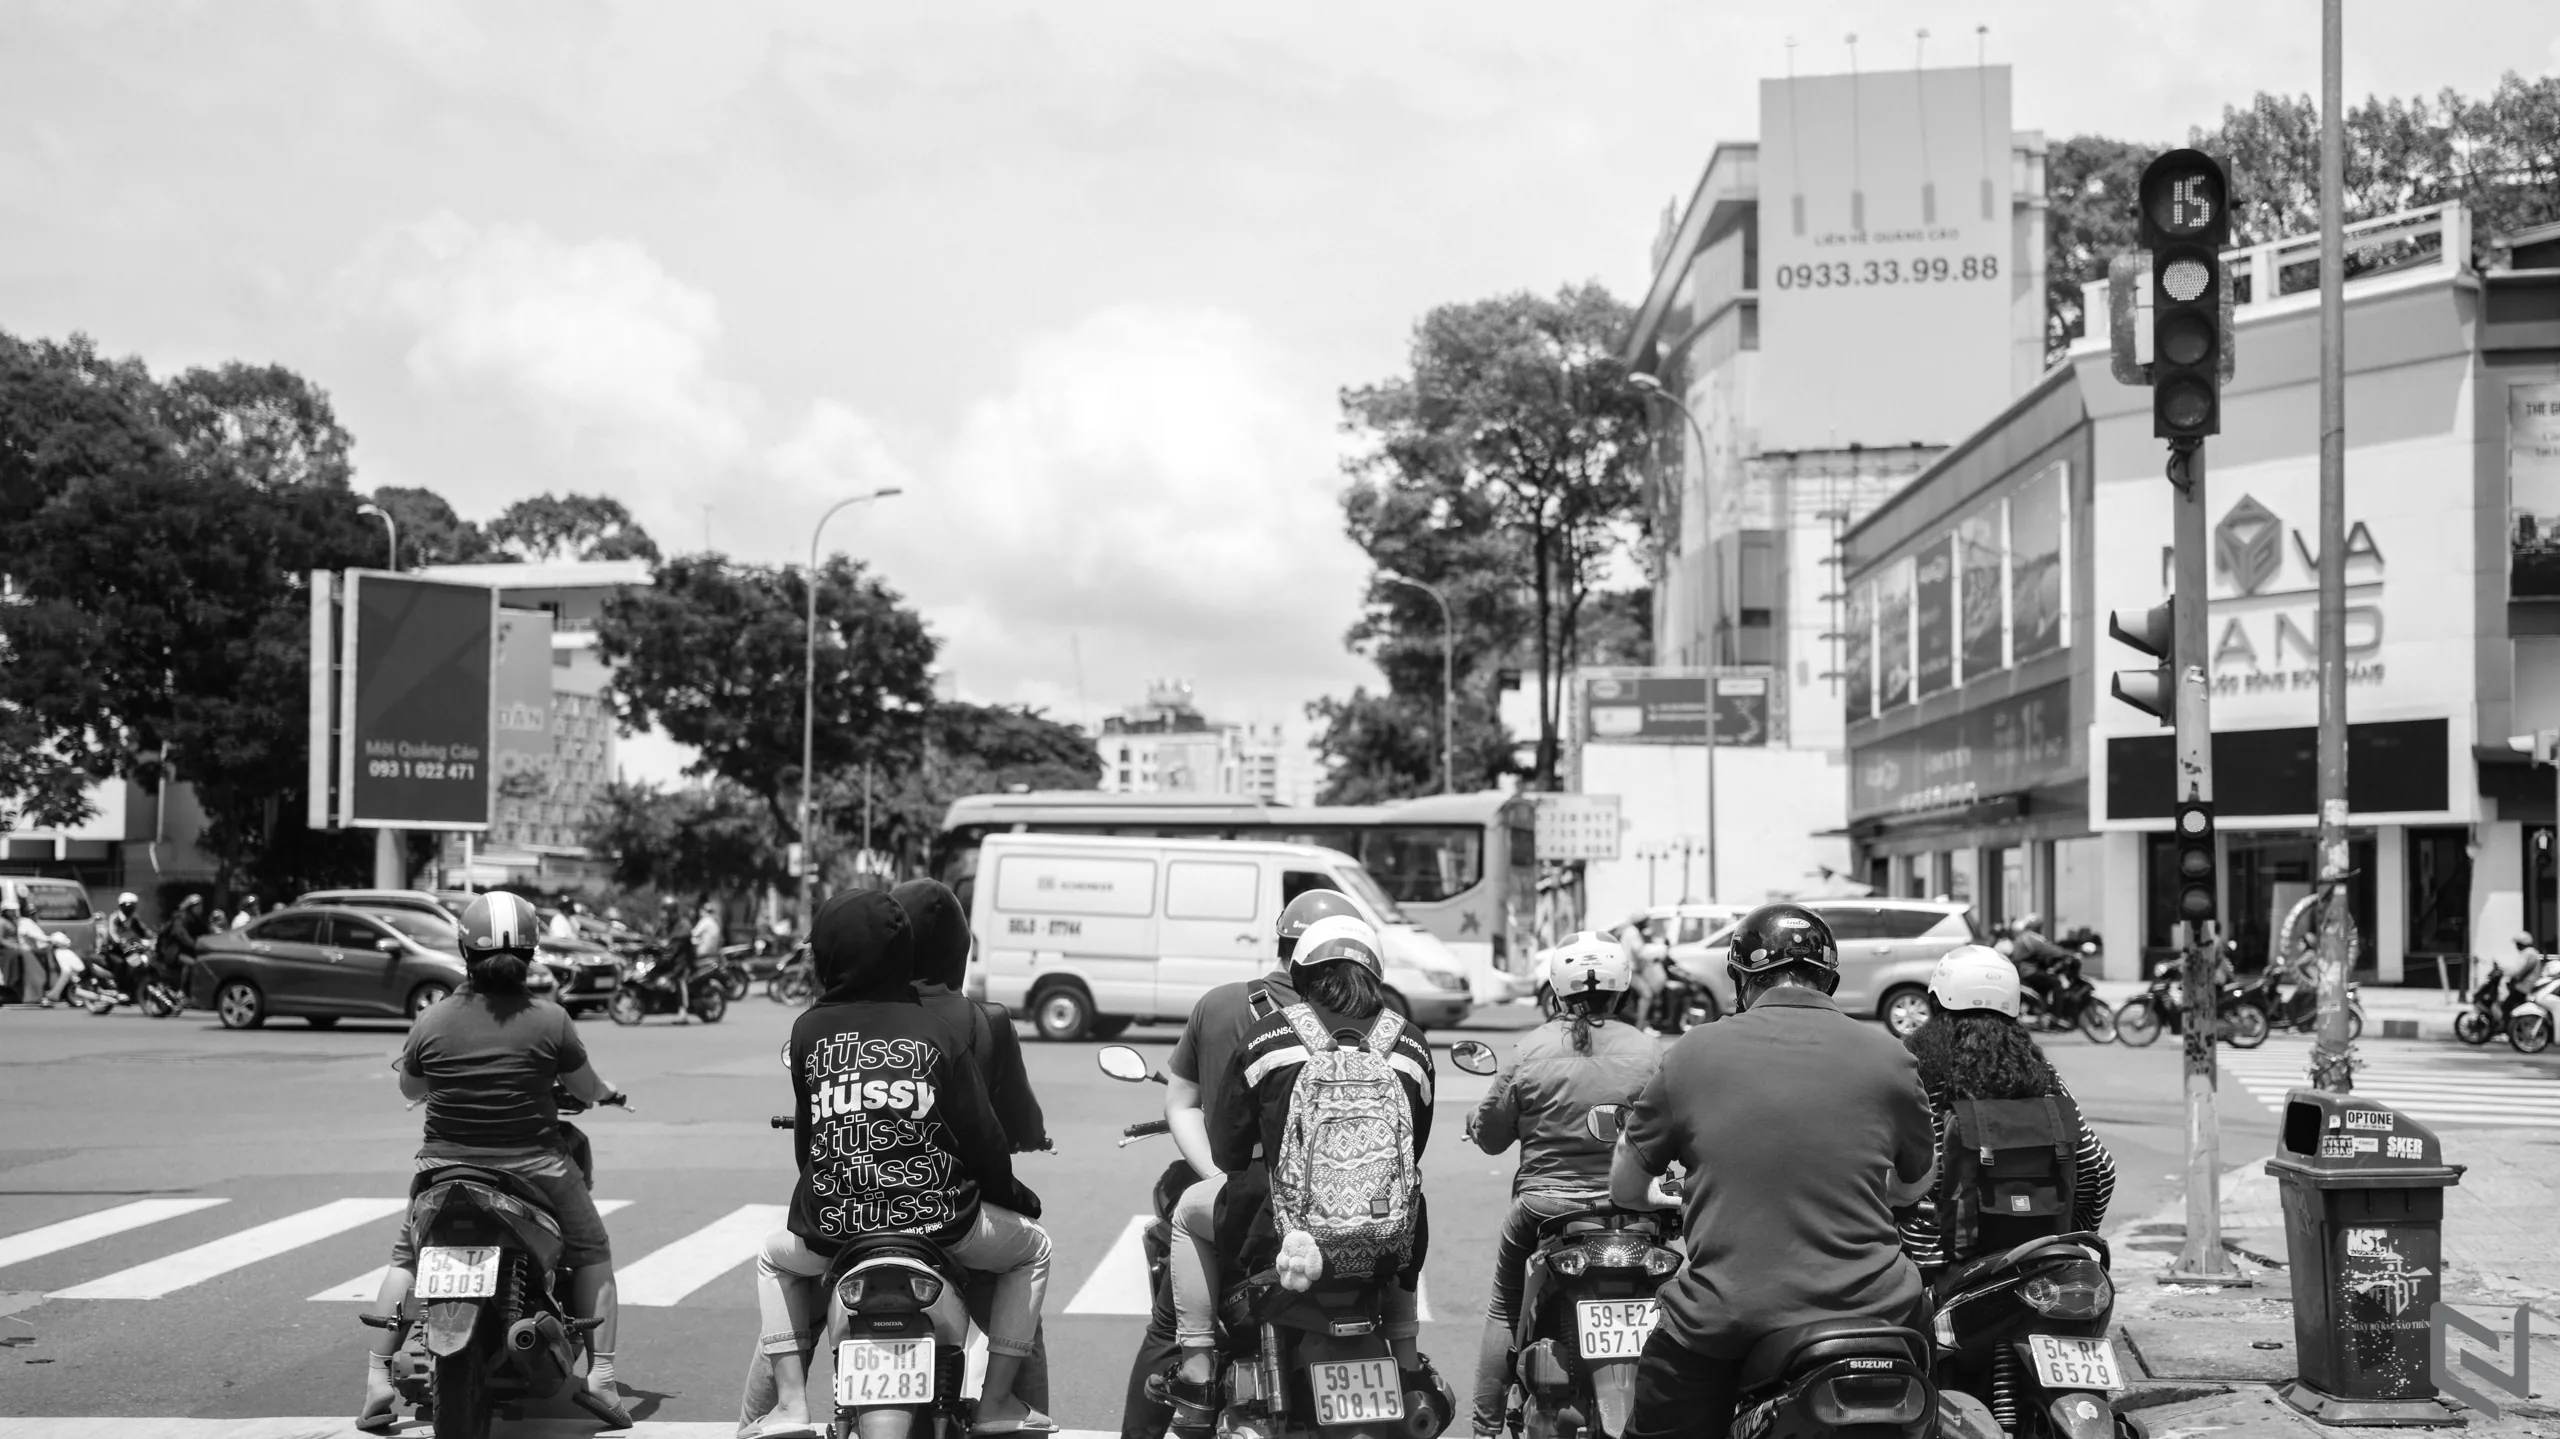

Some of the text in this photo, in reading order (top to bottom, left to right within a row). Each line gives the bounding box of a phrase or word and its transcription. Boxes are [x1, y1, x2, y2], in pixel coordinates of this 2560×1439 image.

[2174, 175, 2210, 228] 15
[1776, 255, 1998, 290] 0933.33.99.88
[2213, 606, 2384, 670] AND
[369, 760, 475, 780] 093 1 022 471
[805, 1031, 941, 1086] stüssy
[811, 1072, 936, 1124] stüssy
[2348, 1111, 2393, 1125] OPTONE
[811, 1113, 942, 1162] stüssy
[2387, 1136, 2423, 1153] SKER
[813, 1151, 953, 1196] stüssy
[820, 1186, 961, 1237] stüssy
[428, 1273, 485, 1294] 0303
[1590, 1304, 1648, 1328] 59-E2
[854, 1344, 917, 1370] 66-H1
[1850, 1360, 1894, 1369] SUZUKI
[2043, 1339, 2104, 1362] 54-R4
[844, 1372, 928, 1401] 142.83
[2050, 1362, 2110, 1385] 6529
[1320, 1390, 1398, 1420] 508.15
